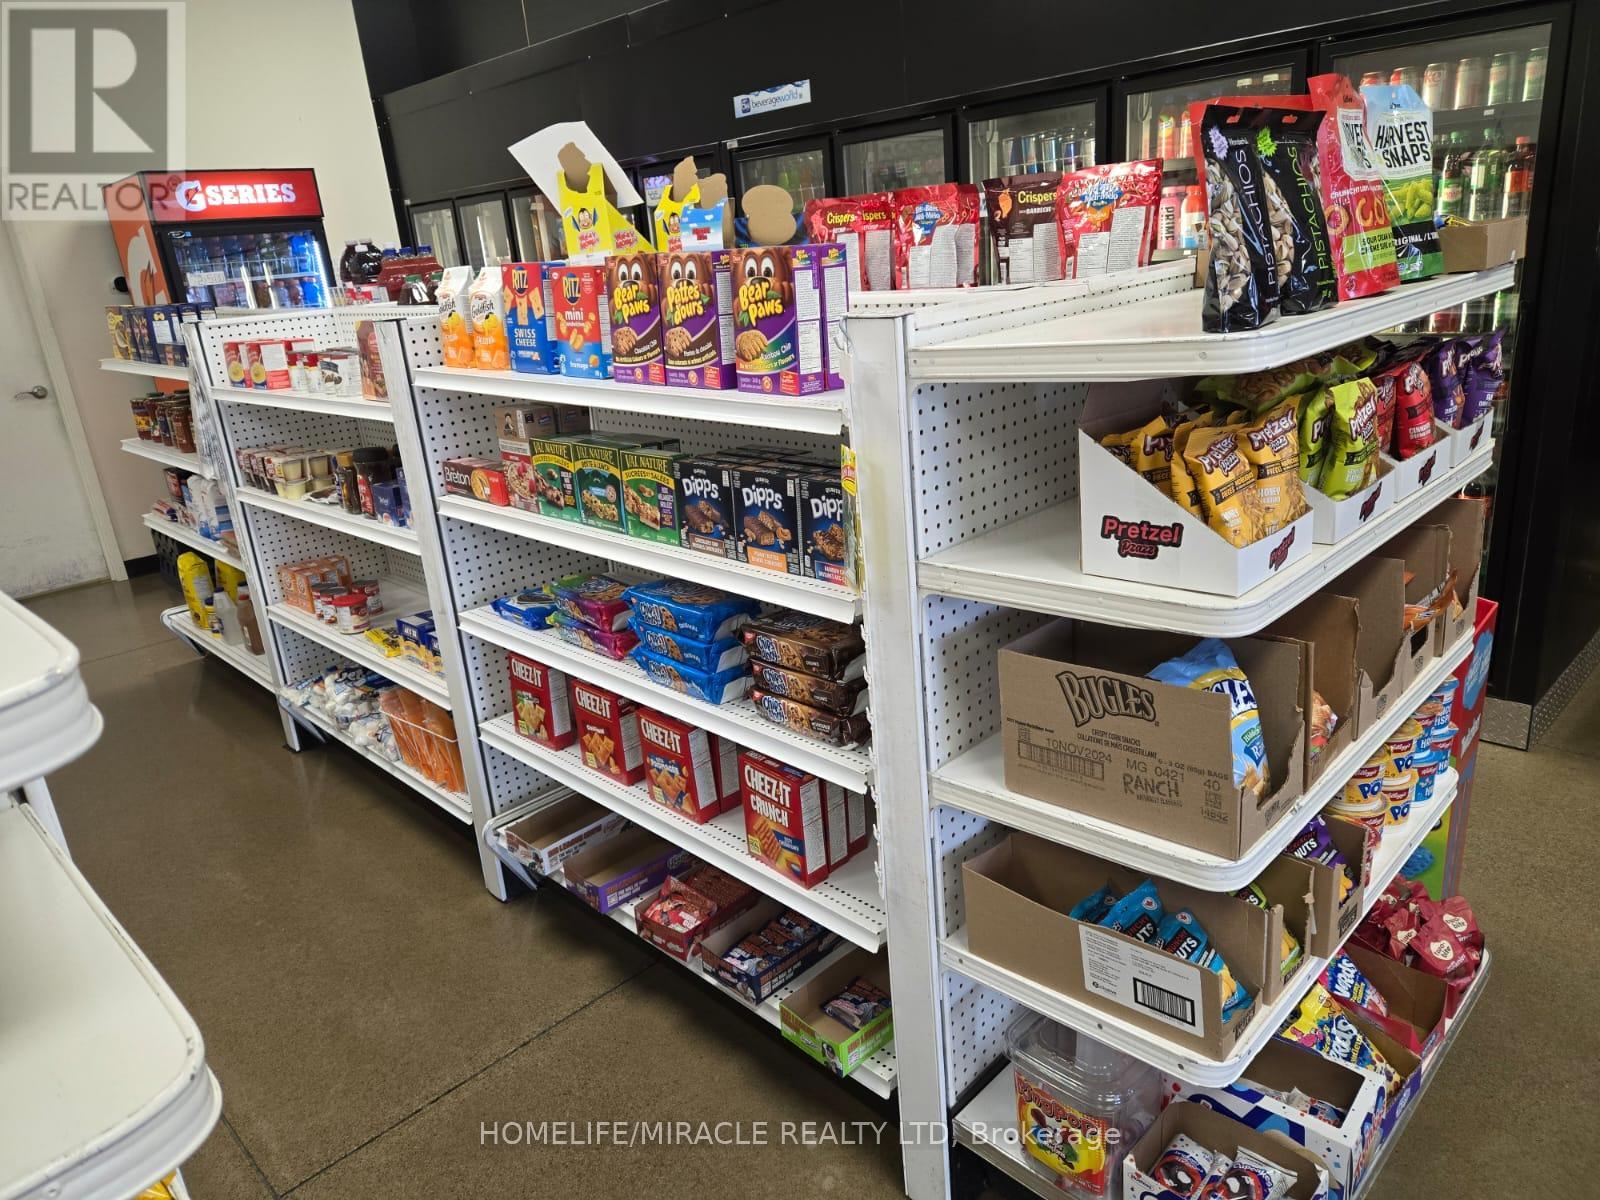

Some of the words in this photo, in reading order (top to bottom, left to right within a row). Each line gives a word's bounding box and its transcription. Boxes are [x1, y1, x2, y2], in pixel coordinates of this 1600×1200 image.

[1375, 121, 1431, 149] HARVEST
[1382, 143, 1431, 168] SNAPS
[208, 183, 296, 204] SERIES
[1017, 190, 1057, 204] Crispers
[862, 211, 886, 222] ispers
[1165, 206, 1174, 241] PRIME
[1235, 149, 1276, 285] PISTACHIOS
[1393, 234, 1422, 247] RIGINAL
[511, 267, 528, 290] RITZ
[563, 276, 581, 298] RITZ
[614, 284, 638, 310] Bear
[667, 281, 700, 306] Pattes
[739, 282, 770, 308] Bear
[471, 299, 494, 319] Goldfish
[565, 308, 584, 321] mini
[514, 328, 536, 339] SWISS
[515, 338, 537, 347] CHEESE
[1249, 409, 1294, 449] Pretzel
[545, 442, 567, 459] NATURE
[576, 445, 588, 459] VAL
[589, 447, 614, 465] NATURE
[444, 466, 470, 487] Breton
[625, 454, 638, 468] VAL
[639, 456, 668, 474] NATURE
[811, 495, 844, 521] Dipp
[1103, 517, 1181, 545] Pretzel
[511, 658, 542, 687] CHEEZ-IT
[575, 687, 611, 718] CHEEZ-IT
[1055, 671, 1156, 727] BUGLES
[641, 718, 681, 754] CHEEZ-IT
[1046, 737, 1112, 763] 10NOV2024
[1126, 758, 1147, 773] MG
[1154, 766, 1185, 783] 0421
[1207, 769, 1229, 781] BAGS
[744, 764, 791, 808] CHEEZ-IT
[1122, 773, 1180, 798] RANCH
[1203, 779, 1221, 792] 40
[750, 794, 789, 828] CRUNCH
[1136, 922, 1154, 942] UTS
